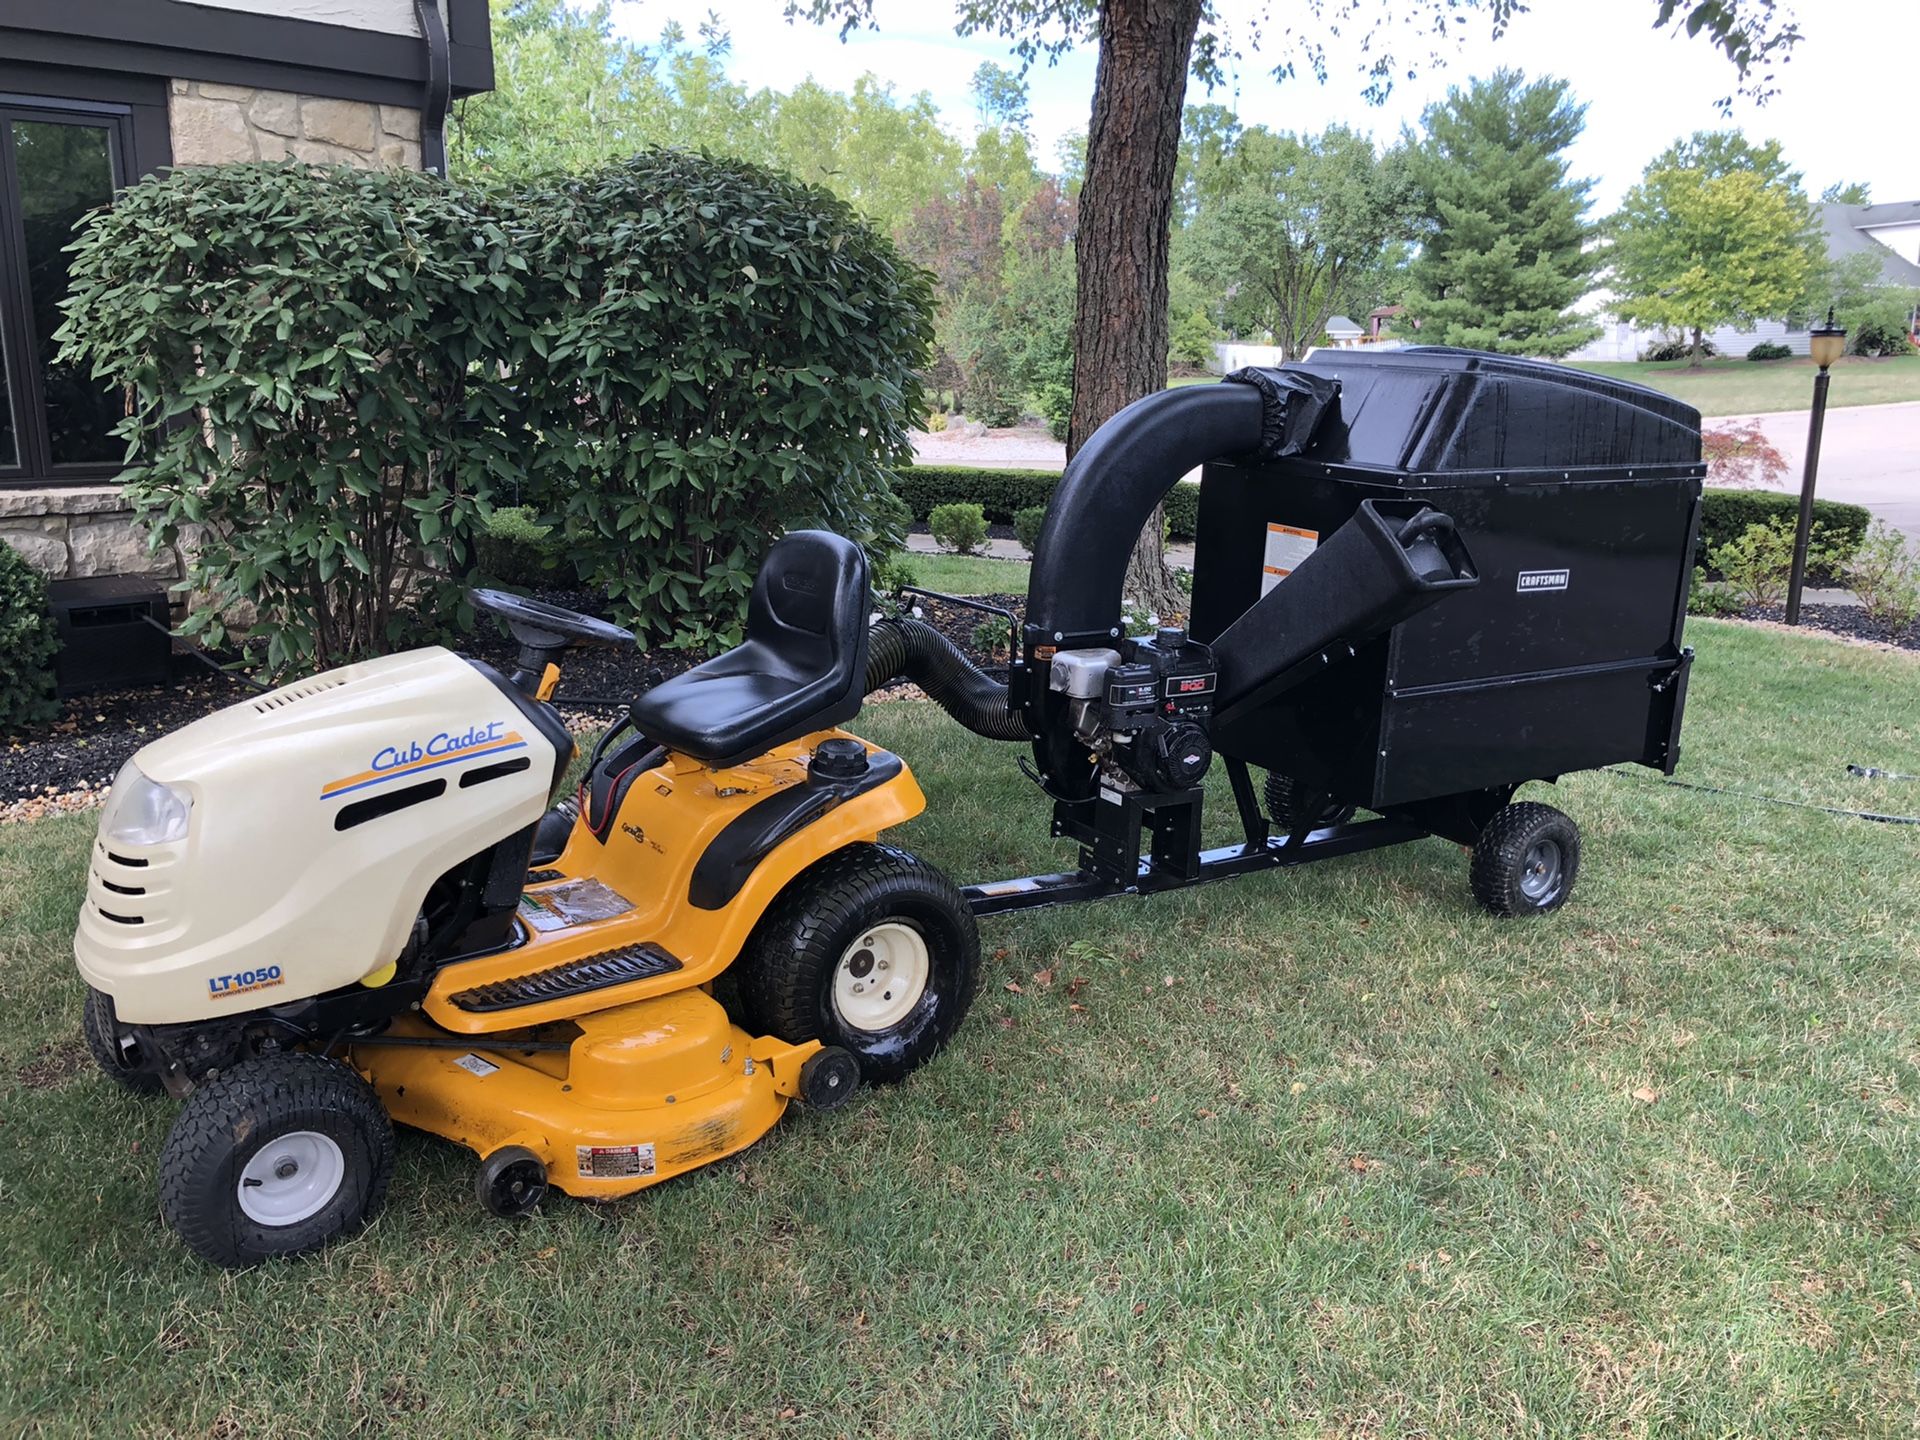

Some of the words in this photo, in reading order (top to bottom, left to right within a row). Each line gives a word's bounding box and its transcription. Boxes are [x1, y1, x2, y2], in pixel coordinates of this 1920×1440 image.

[1521, 574, 1566, 587] CRAFTSMAN
[371, 741, 423, 772] Cub
[426, 721, 504, 756] Cadet
[209, 965, 281, 993] LT1050
